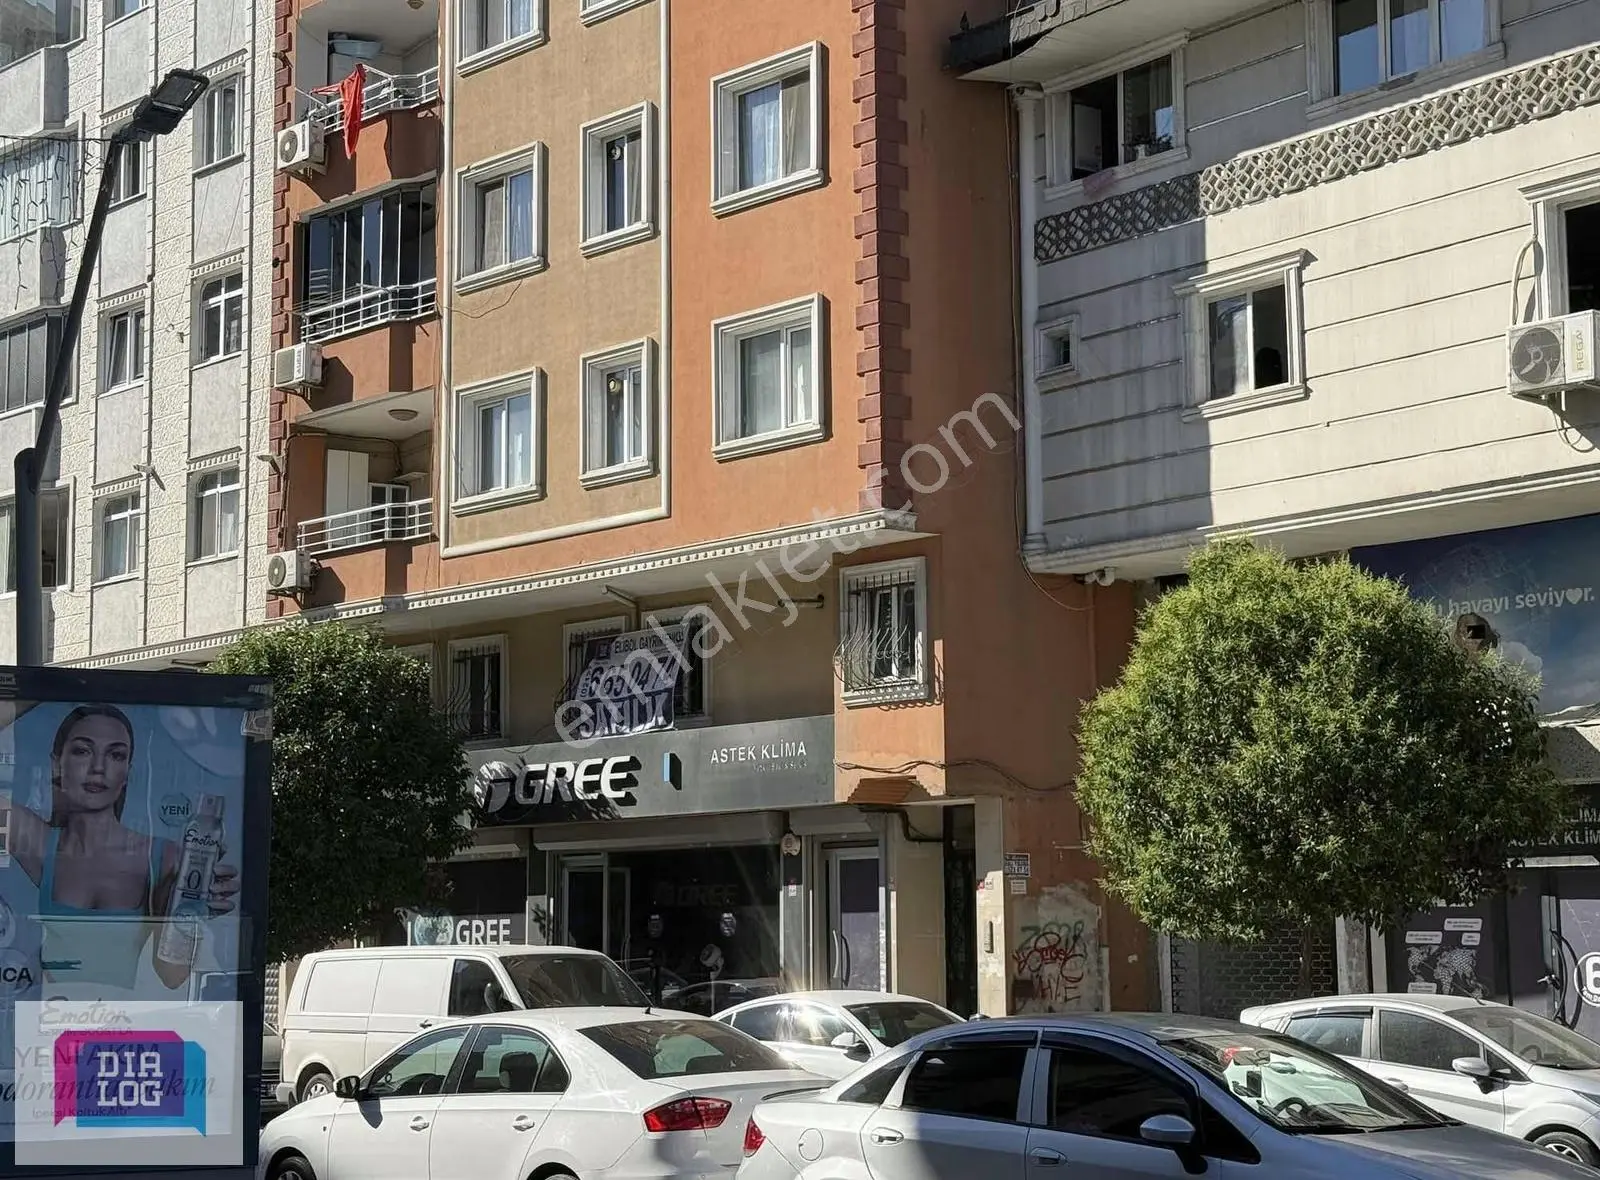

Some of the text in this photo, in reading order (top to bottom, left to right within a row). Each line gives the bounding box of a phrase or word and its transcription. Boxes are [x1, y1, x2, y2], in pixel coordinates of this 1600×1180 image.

[710, 739, 807, 764] ASTEK KLİMA
[514, 755, 632, 805] GREE
[161, 805, 190, 817] YENİ
[455, 918, 511, 946] GREE
[0, 966, 33, 983] CA
